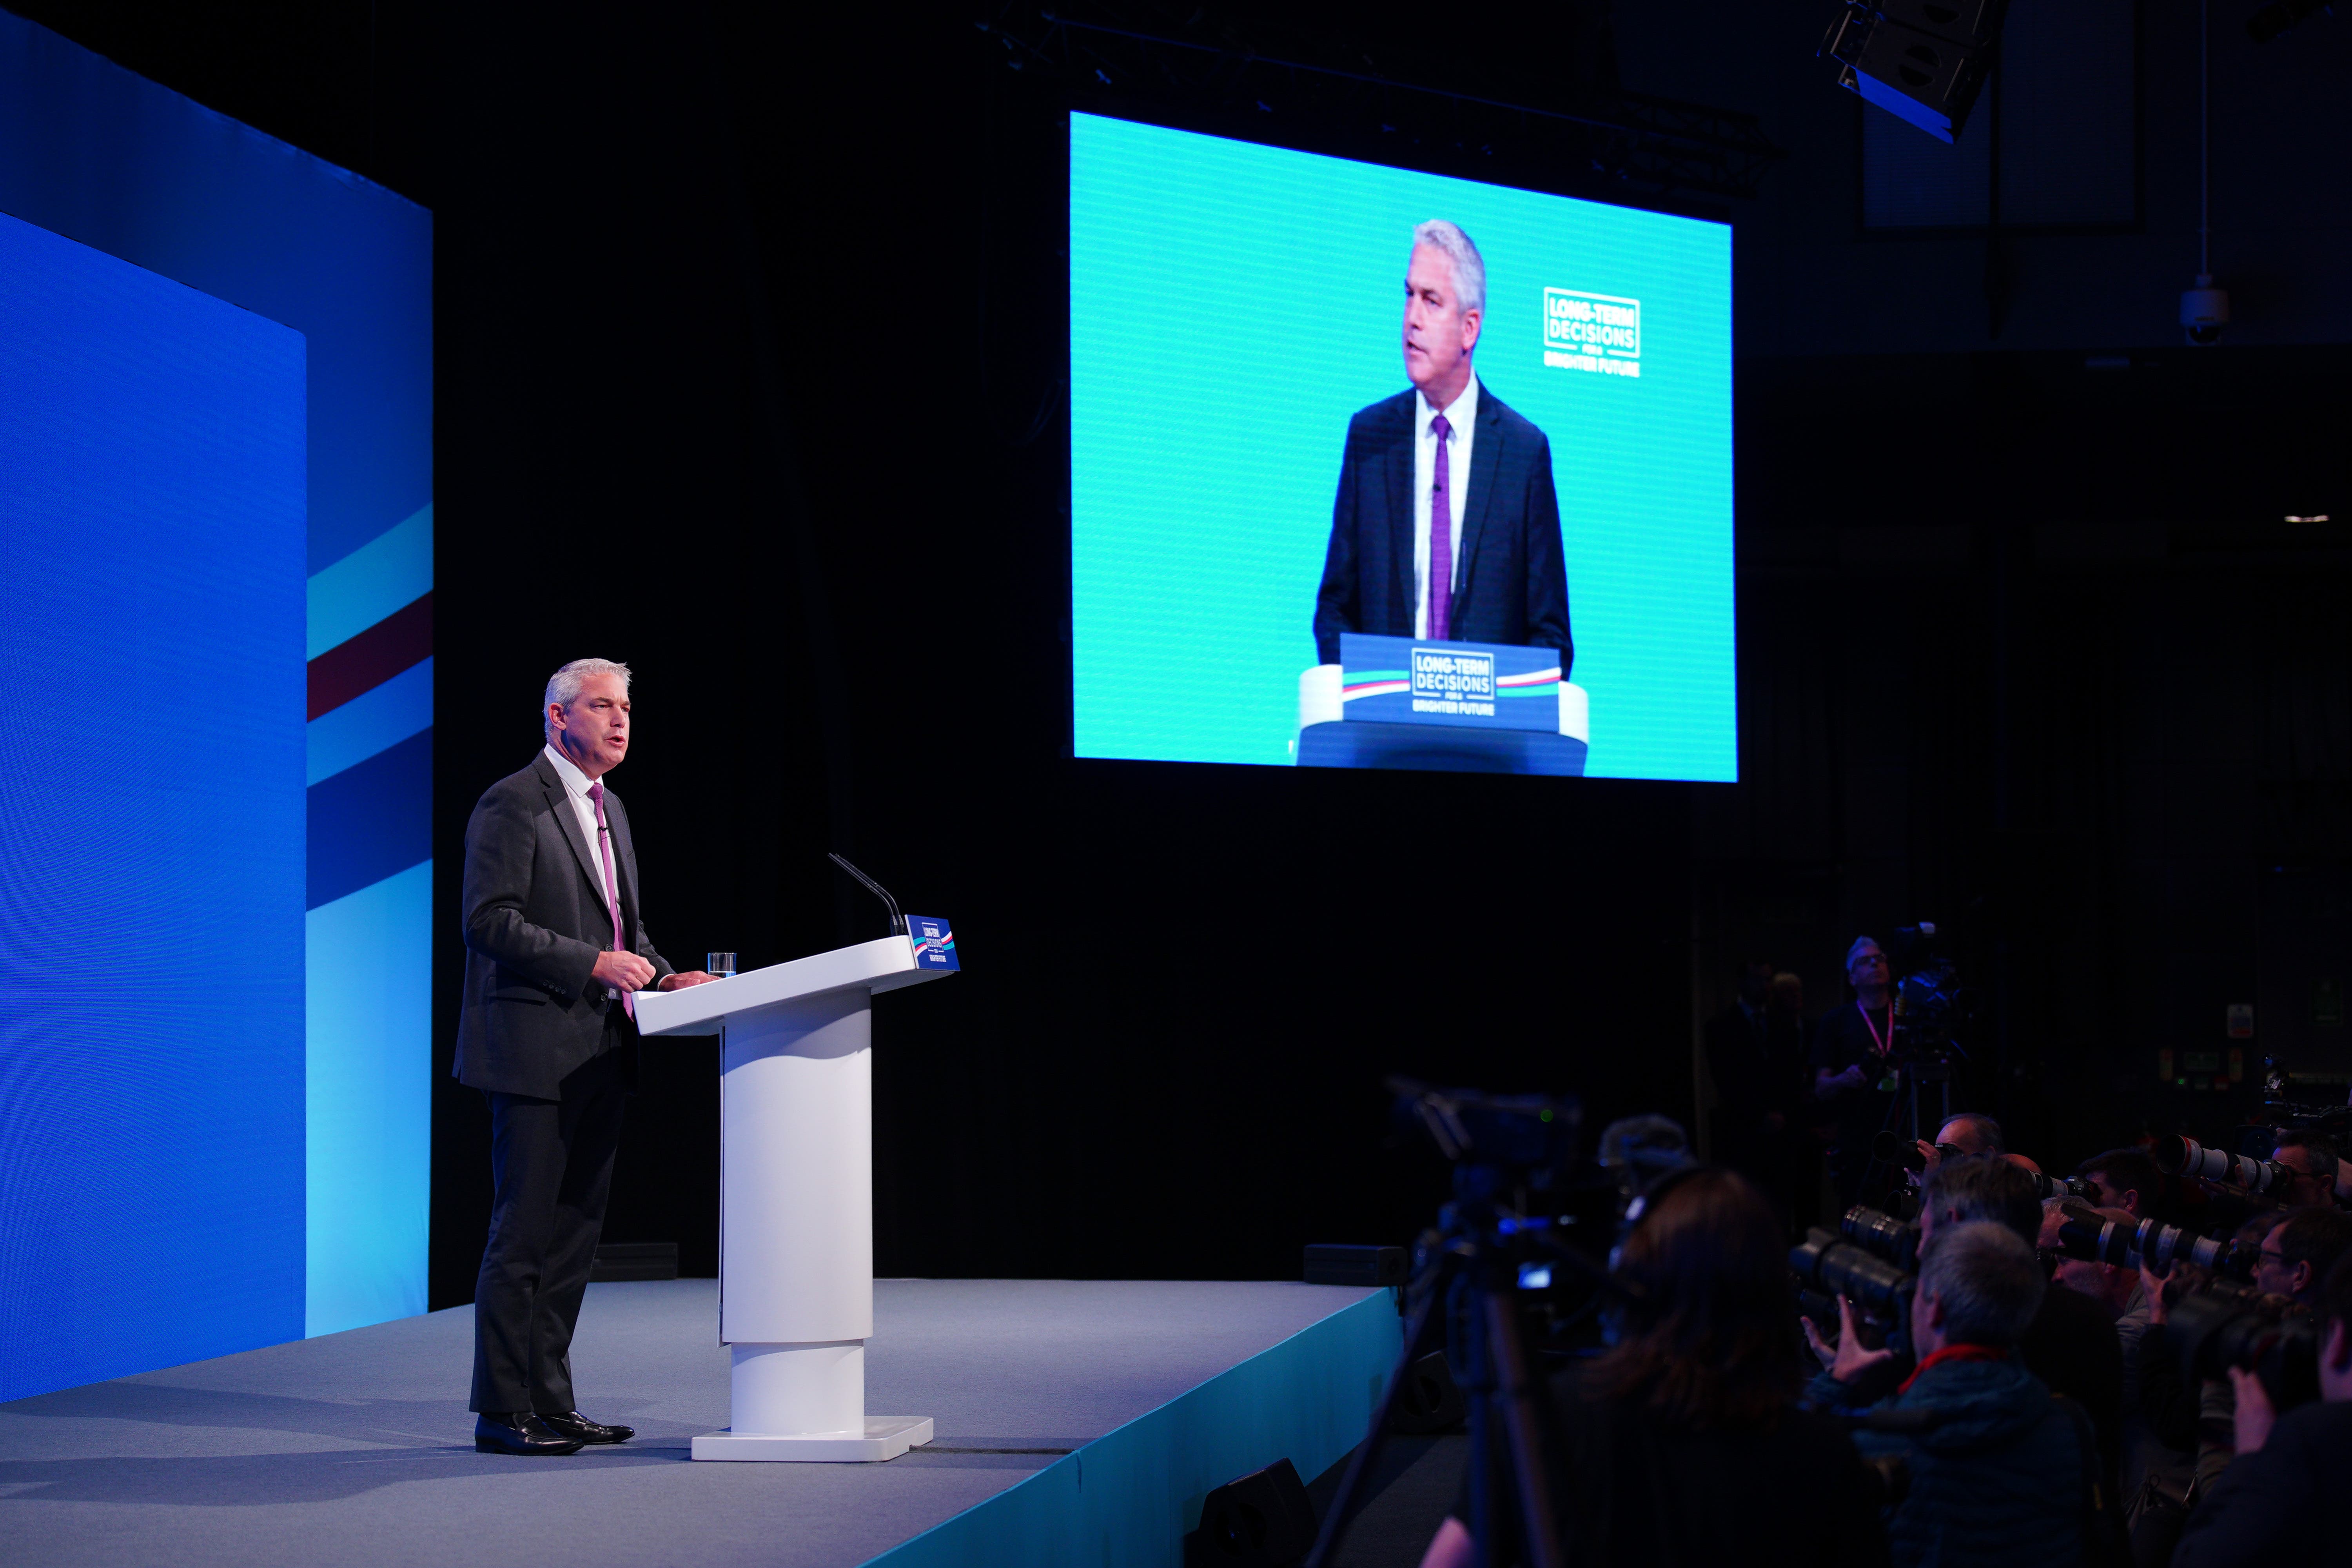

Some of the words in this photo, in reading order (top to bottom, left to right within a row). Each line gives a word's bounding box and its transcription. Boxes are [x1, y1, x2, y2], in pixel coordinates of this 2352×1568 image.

[1549, 297, 1635, 328] LONG-TERM
[1549, 318, 1635, 348] DECISIONS
[1544, 350, 1597, 372] BRIGHTER
[1598, 358, 1640, 378] FUTURE
[1416, 655, 1490, 676] LONG-TERM
[1417, 673, 1490, 693] DECISIONS
[1412, 699, 1458, 714] BRIGHTER
[1458, 702, 1495, 717] FUTURE
